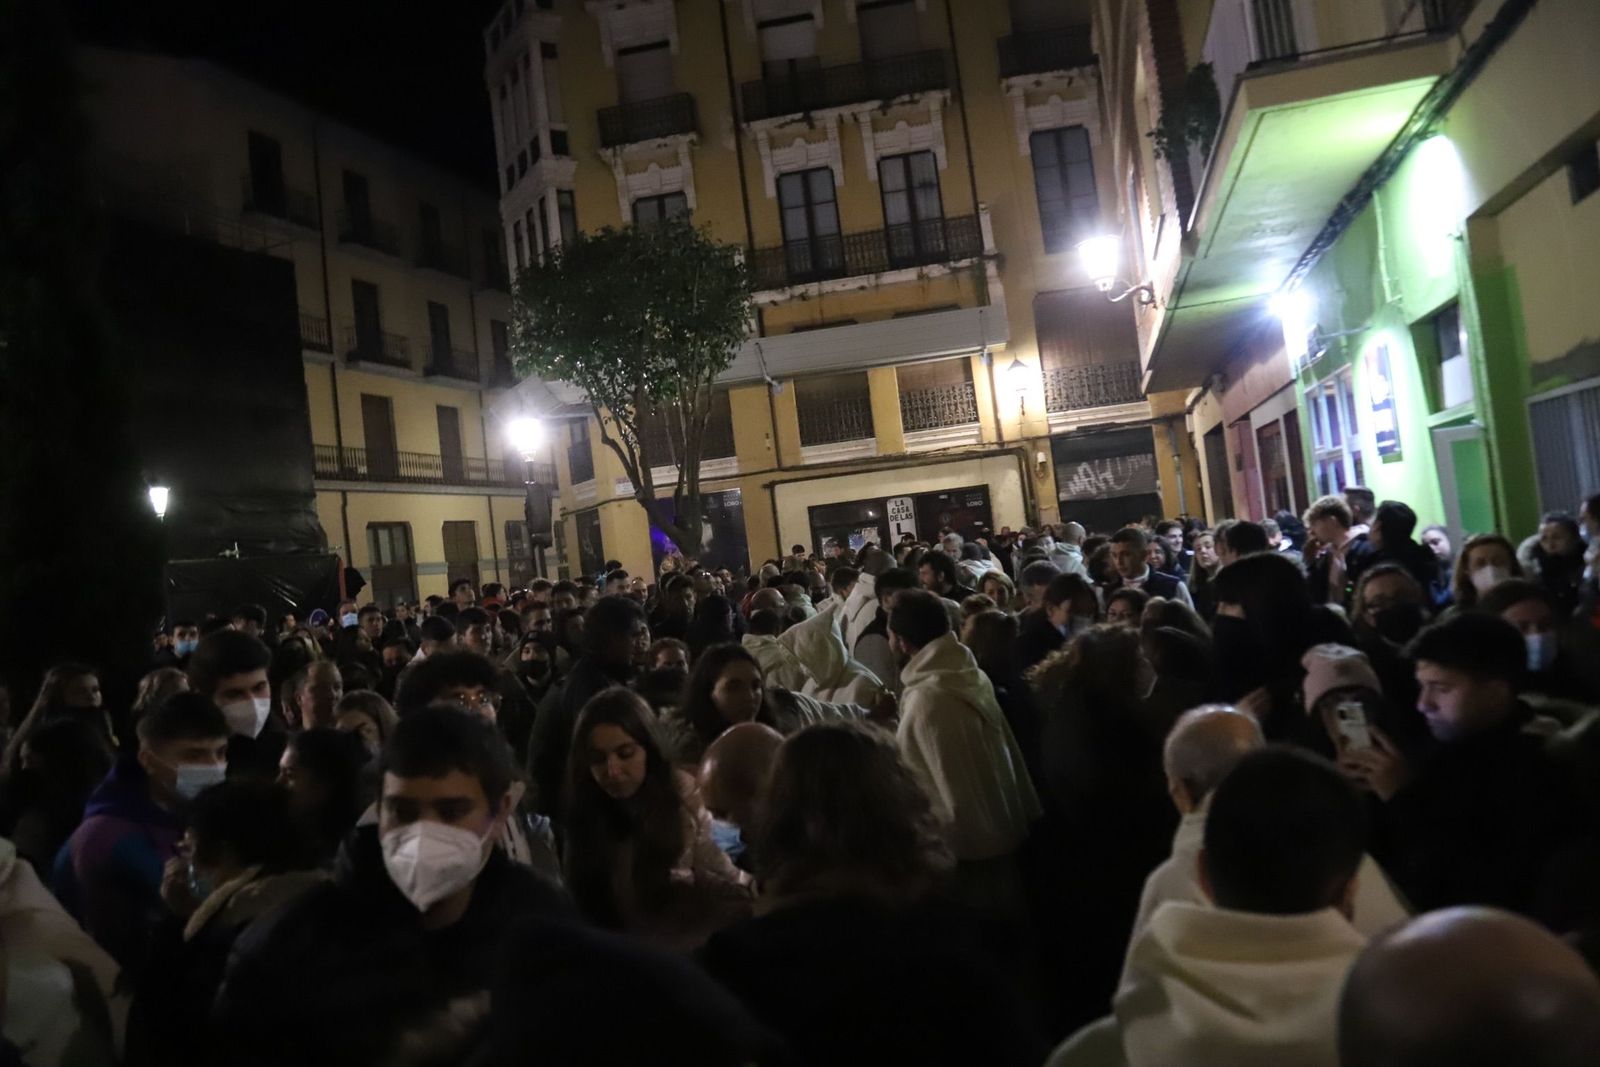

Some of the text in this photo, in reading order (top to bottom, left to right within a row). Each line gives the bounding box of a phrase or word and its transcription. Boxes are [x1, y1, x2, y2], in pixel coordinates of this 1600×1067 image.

[894, 499, 904, 507] LA
[891, 506, 910, 514] CASA
[900, 512, 913, 520] LAS
